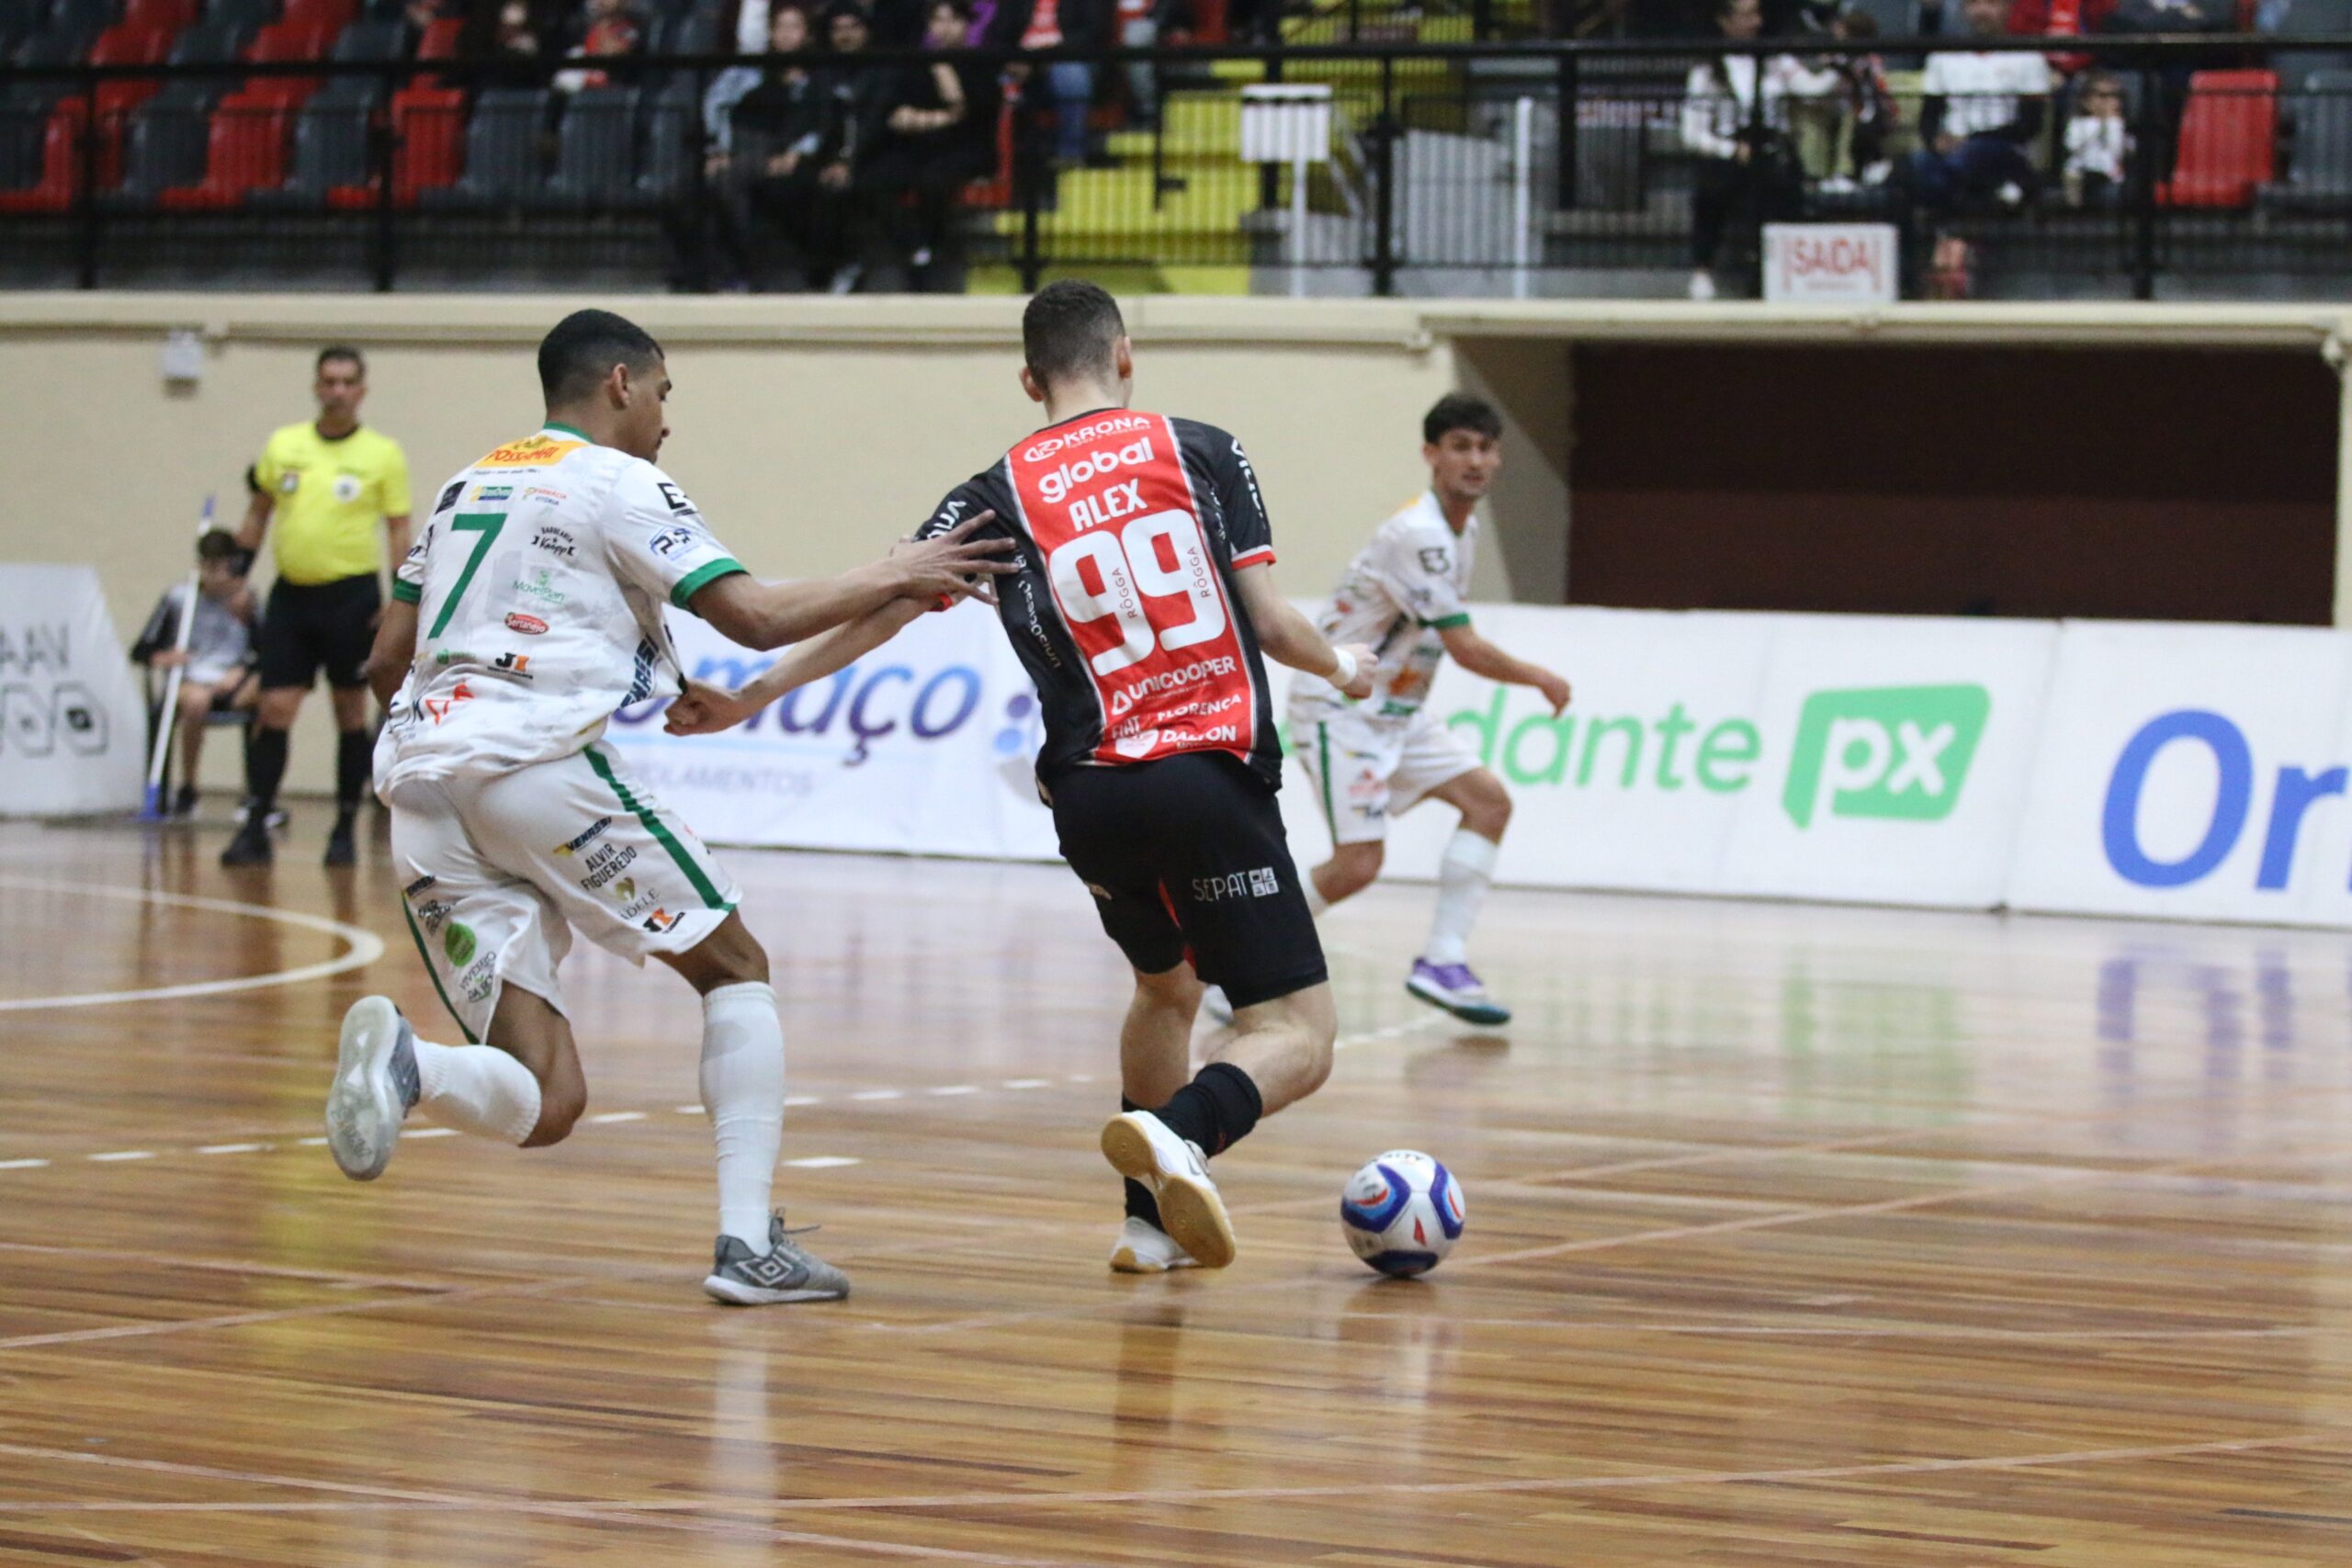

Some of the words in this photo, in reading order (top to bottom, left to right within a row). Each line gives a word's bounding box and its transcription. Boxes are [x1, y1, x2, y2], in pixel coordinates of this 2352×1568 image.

[1064, 417, 1149, 445] KRONA
[1038, 436, 1154, 503] global
[1069, 478, 1148, 532] ALEX
[427, 513, 508, 639] 7
[1049, 508, 1227, 677] 99
[1447, 686, 1762, 793] dante
[1808, 718, 1957, 829] px
[2103, 708, 2352, 891] Or
[581, 845, 638, 891] FIGUEREDO
[585, 843, 616, 872] ALVIR
[1193, 873, 1248, 902] SEPAT
